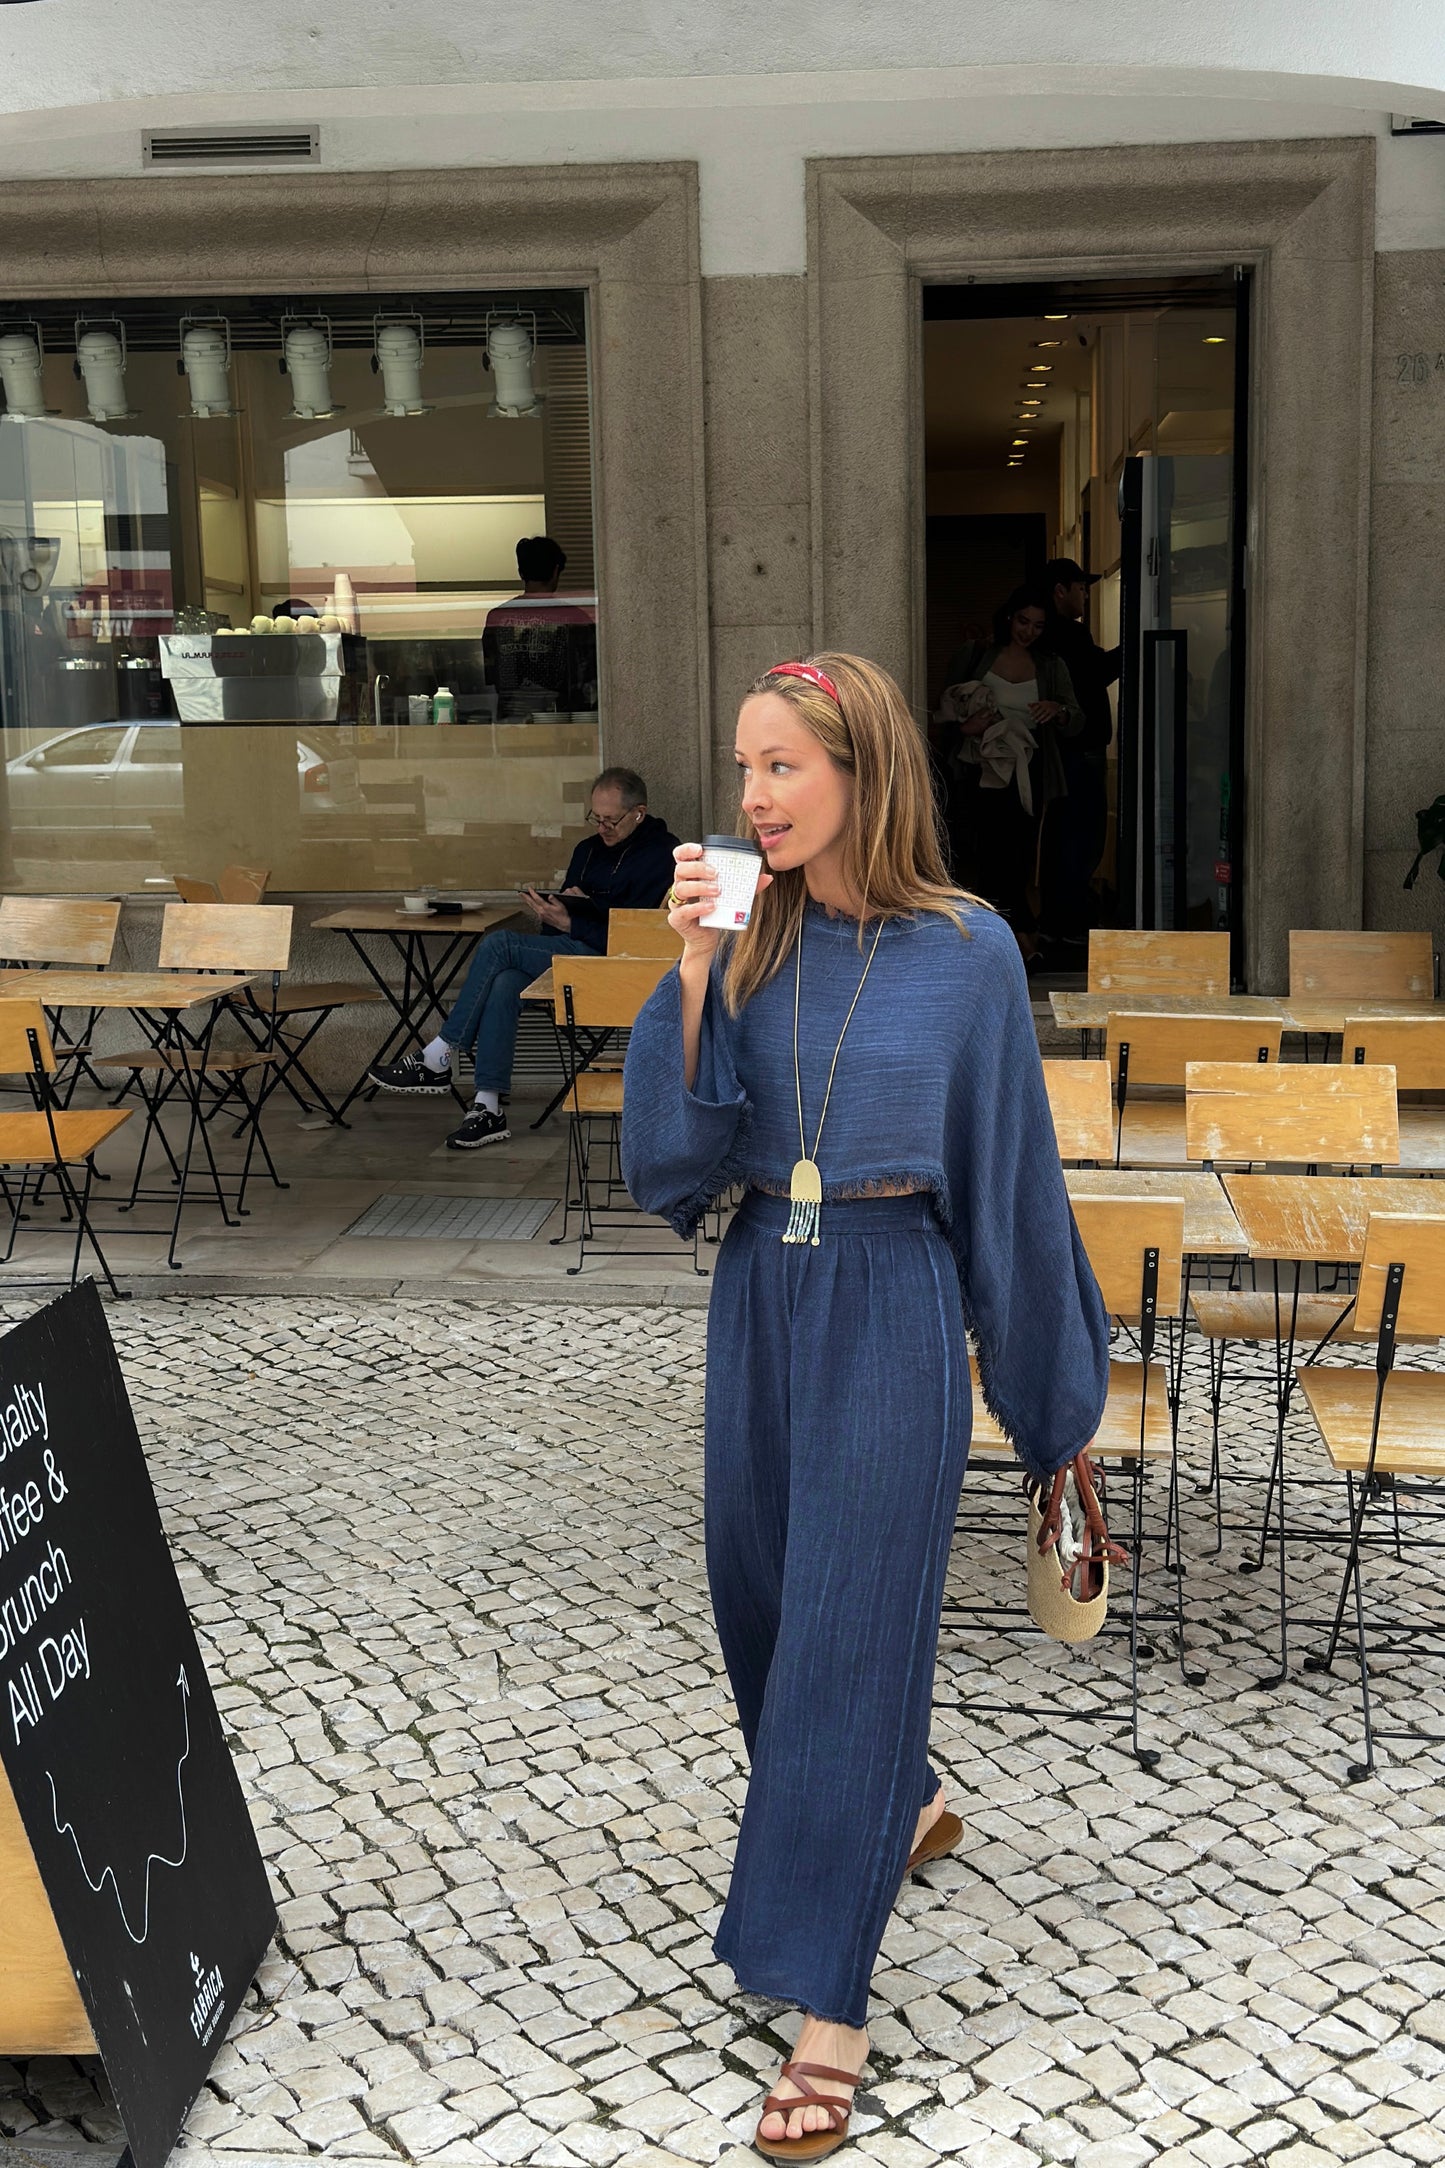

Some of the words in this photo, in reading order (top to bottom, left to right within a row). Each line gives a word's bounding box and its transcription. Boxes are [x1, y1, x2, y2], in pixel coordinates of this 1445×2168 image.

[43, 1448, 69, 1504] &
[7, 1661, 44, 1746] All
[38, 1617, 91, 1701] Day
[189, 1964, 225, 2040] FÁBRICA
